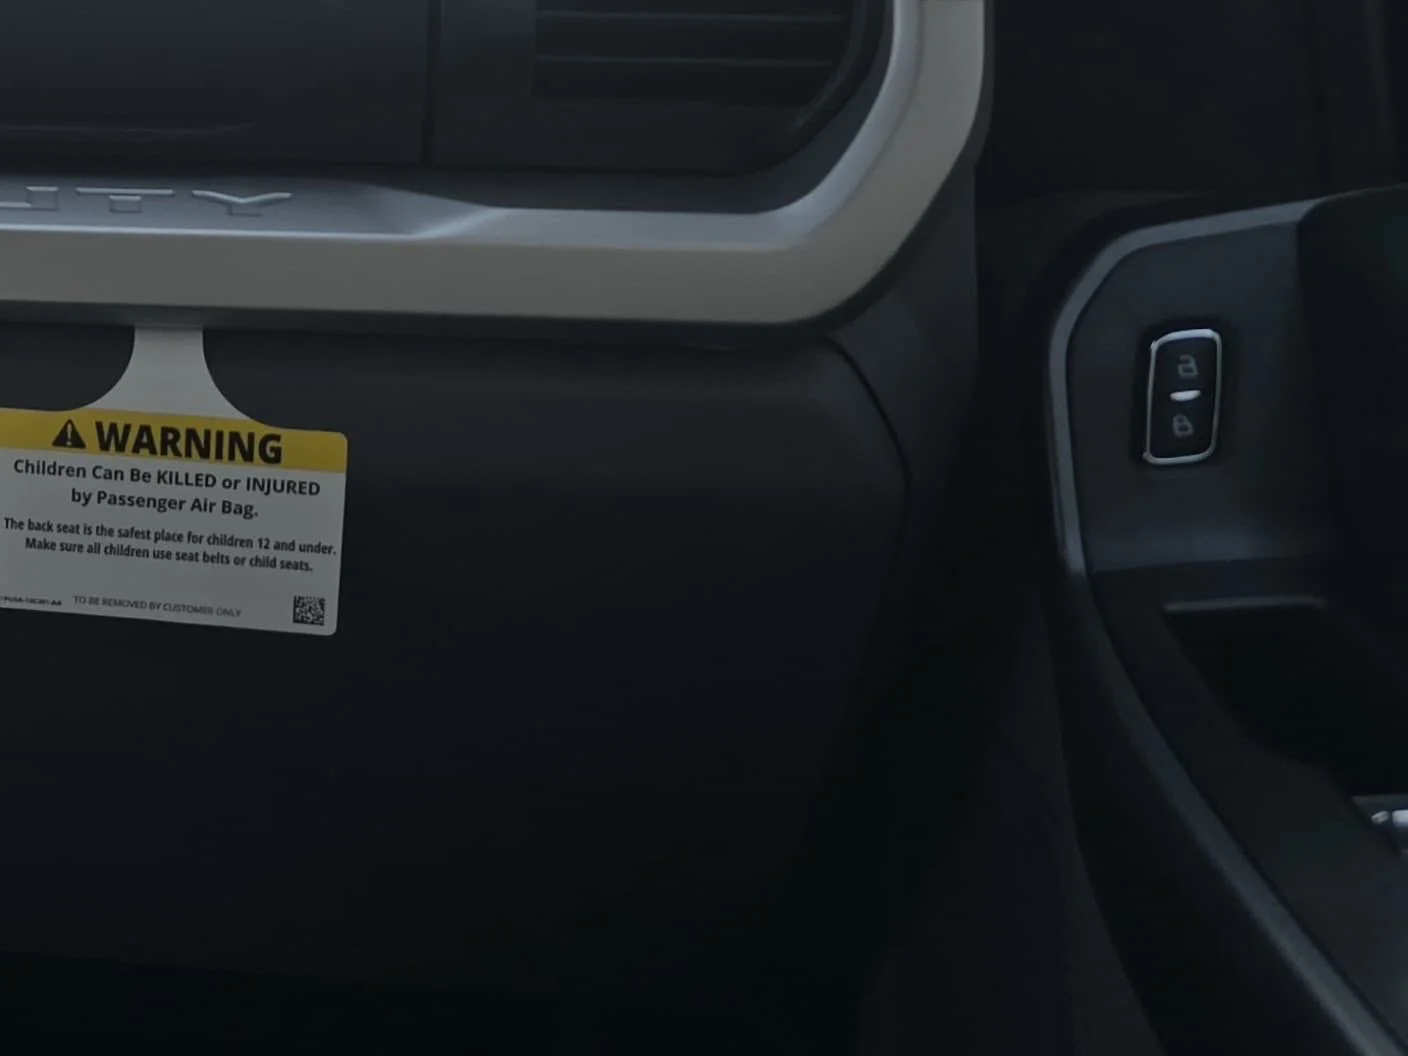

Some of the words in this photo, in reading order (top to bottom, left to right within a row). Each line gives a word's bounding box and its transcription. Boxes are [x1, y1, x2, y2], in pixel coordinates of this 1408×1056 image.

[95, 420, 283, 465] WARNING
[14, 459, 87, 479] Children
[92, 465, 124, 481] Can
[130, 468, 152, 484] Be
[156, 469, 217, 489] KILLED
[222, 477, 241, 490] or
[246, 476, 321, 497] INJURED
[71, 488, 93, 508] by
[96, 490, 187, 514] Passenger
[190, 498, 217, 513] Air
[221, 500, 259, 520] Bag.
[4, 517, 25, 531] The
[27, 518, 54, 533] back
[57, 523, 81, 535] seat
[83, 524, 93, 535] is
[95, 524, 115, 538] the
[117, 526, 151, 541] safest
[153, 528, 184, 544] place
[187, 531, 204, 544] for
[206, 532, 254, 549] children
[257, 537, 270, 550] 12
[273, 539, 296, 552] and
[298, 542, 337, 556] under.
[25, 537, 57, 551] Make
[59, 541, 85, 554] sure
[86, 543, 101, 555] all
[103, 543, 150, 559] children
[152, 548, 172, 560] use
[175, 549, 200, 563] seat
[202, 550, 230, 565] belts
[233, 555, 246, 566] or
[248, 555, 277, 569] child
[279, 558, 314, 573] seats.
[73, 595, 86, 605] TO
[88, 597, 100, 606] BE
[102, 597, 147, 610] REMOVED
[149, 601, 162, 611] BY
[163, 602, 215, 616] CUSTOMER
[216, 606, 242, 618] ONLY
